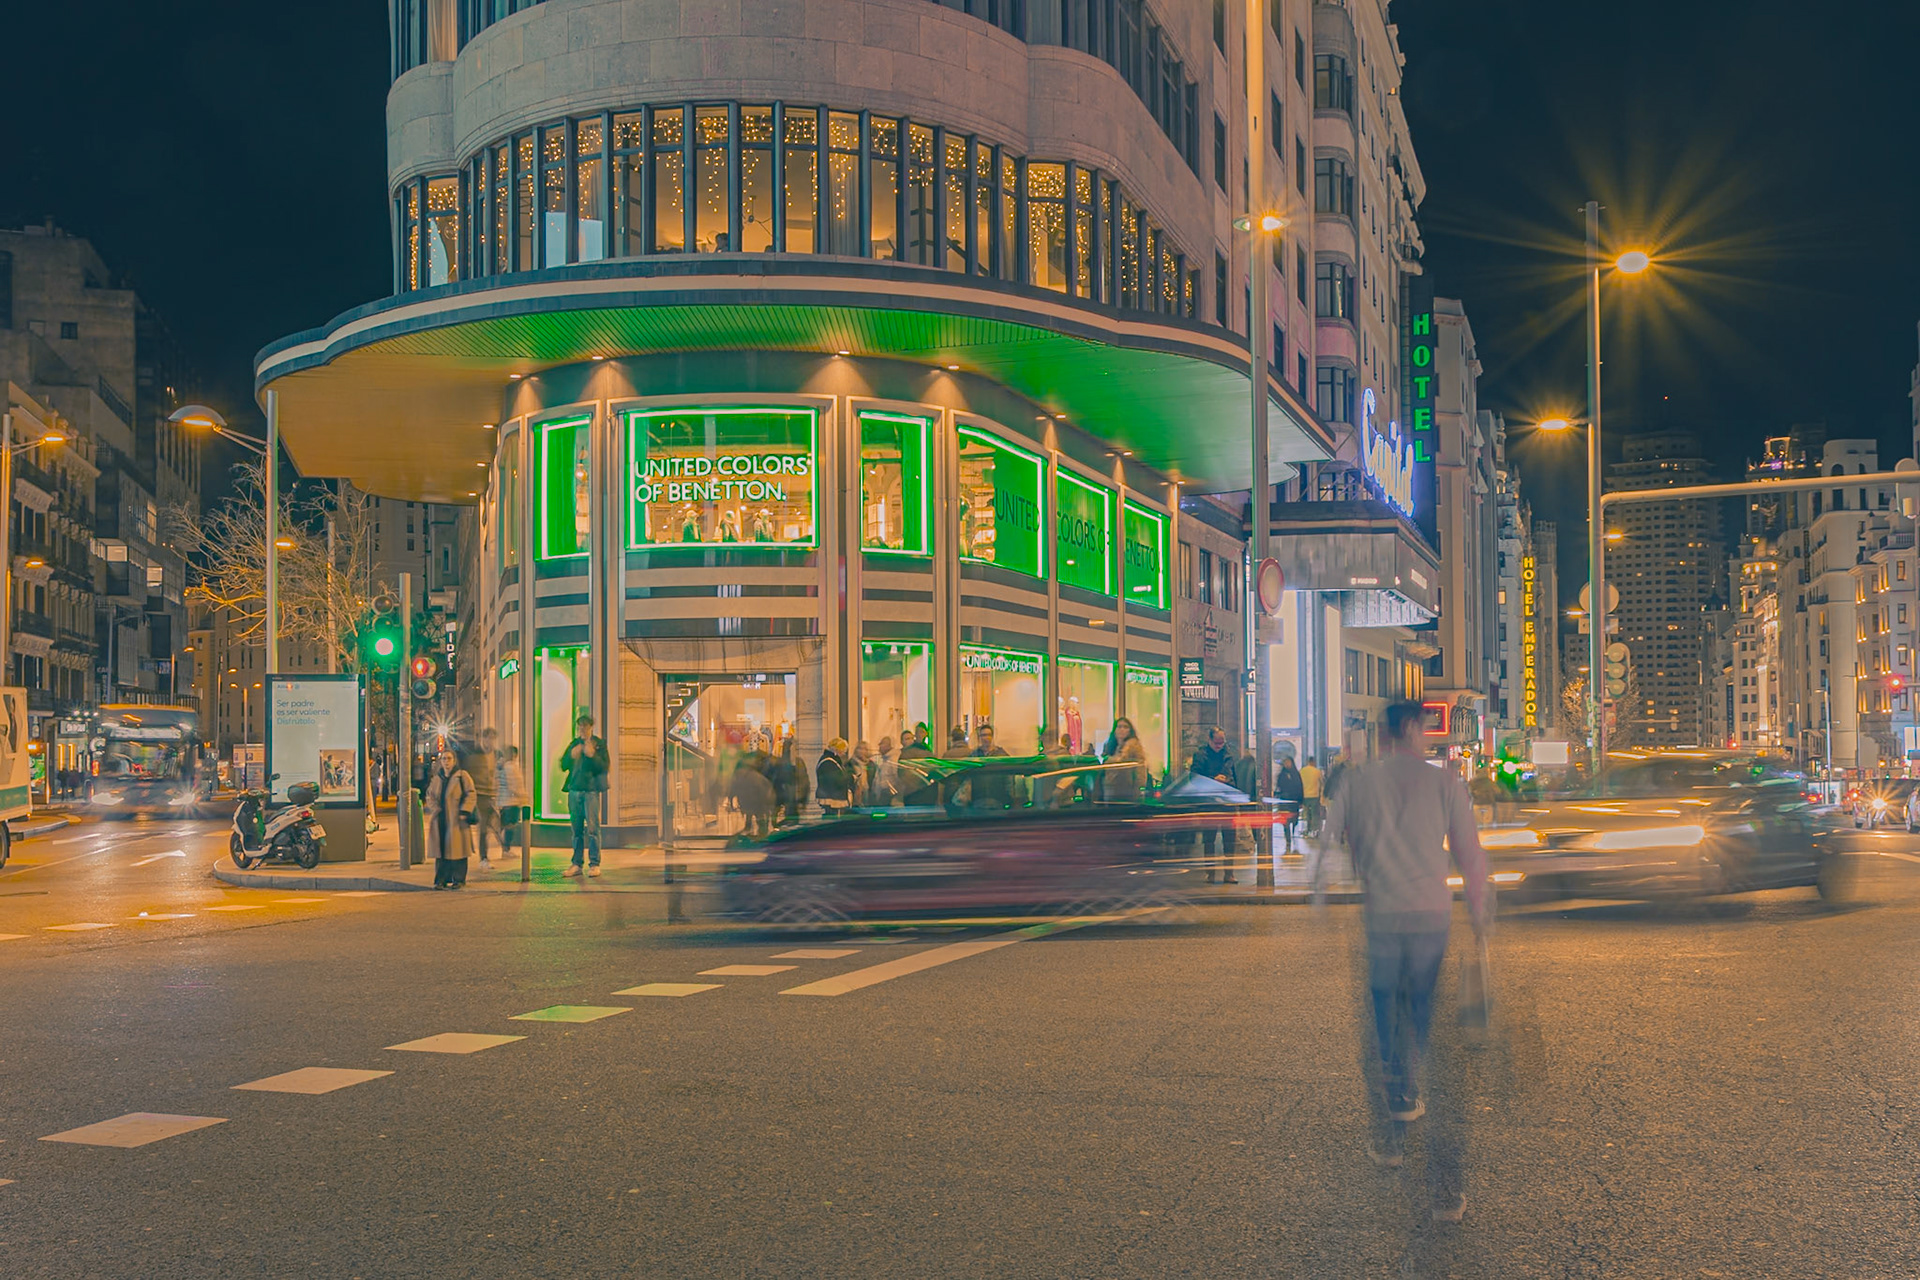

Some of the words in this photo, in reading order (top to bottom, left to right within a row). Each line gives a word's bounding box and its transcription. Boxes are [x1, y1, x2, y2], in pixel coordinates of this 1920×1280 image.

[1412, 312, 1432, 463] HOTEL
[635, 457, 712, 479] UNITED
[717, 455, 809, 477] COLORS
[635, 482, 663, 503] OF
[668, 480, 787, 502] BENETTON.
[994, 487, 1041, 533] UNITED
[1523, 556, 1535, 616] HOTEL
[1524, 621, 1537, 727] EMPERADOR
[276, 699, 289, 707] Ser
[291, 699, 315, 708] padre
[299, 708, 331, 716] valiente
